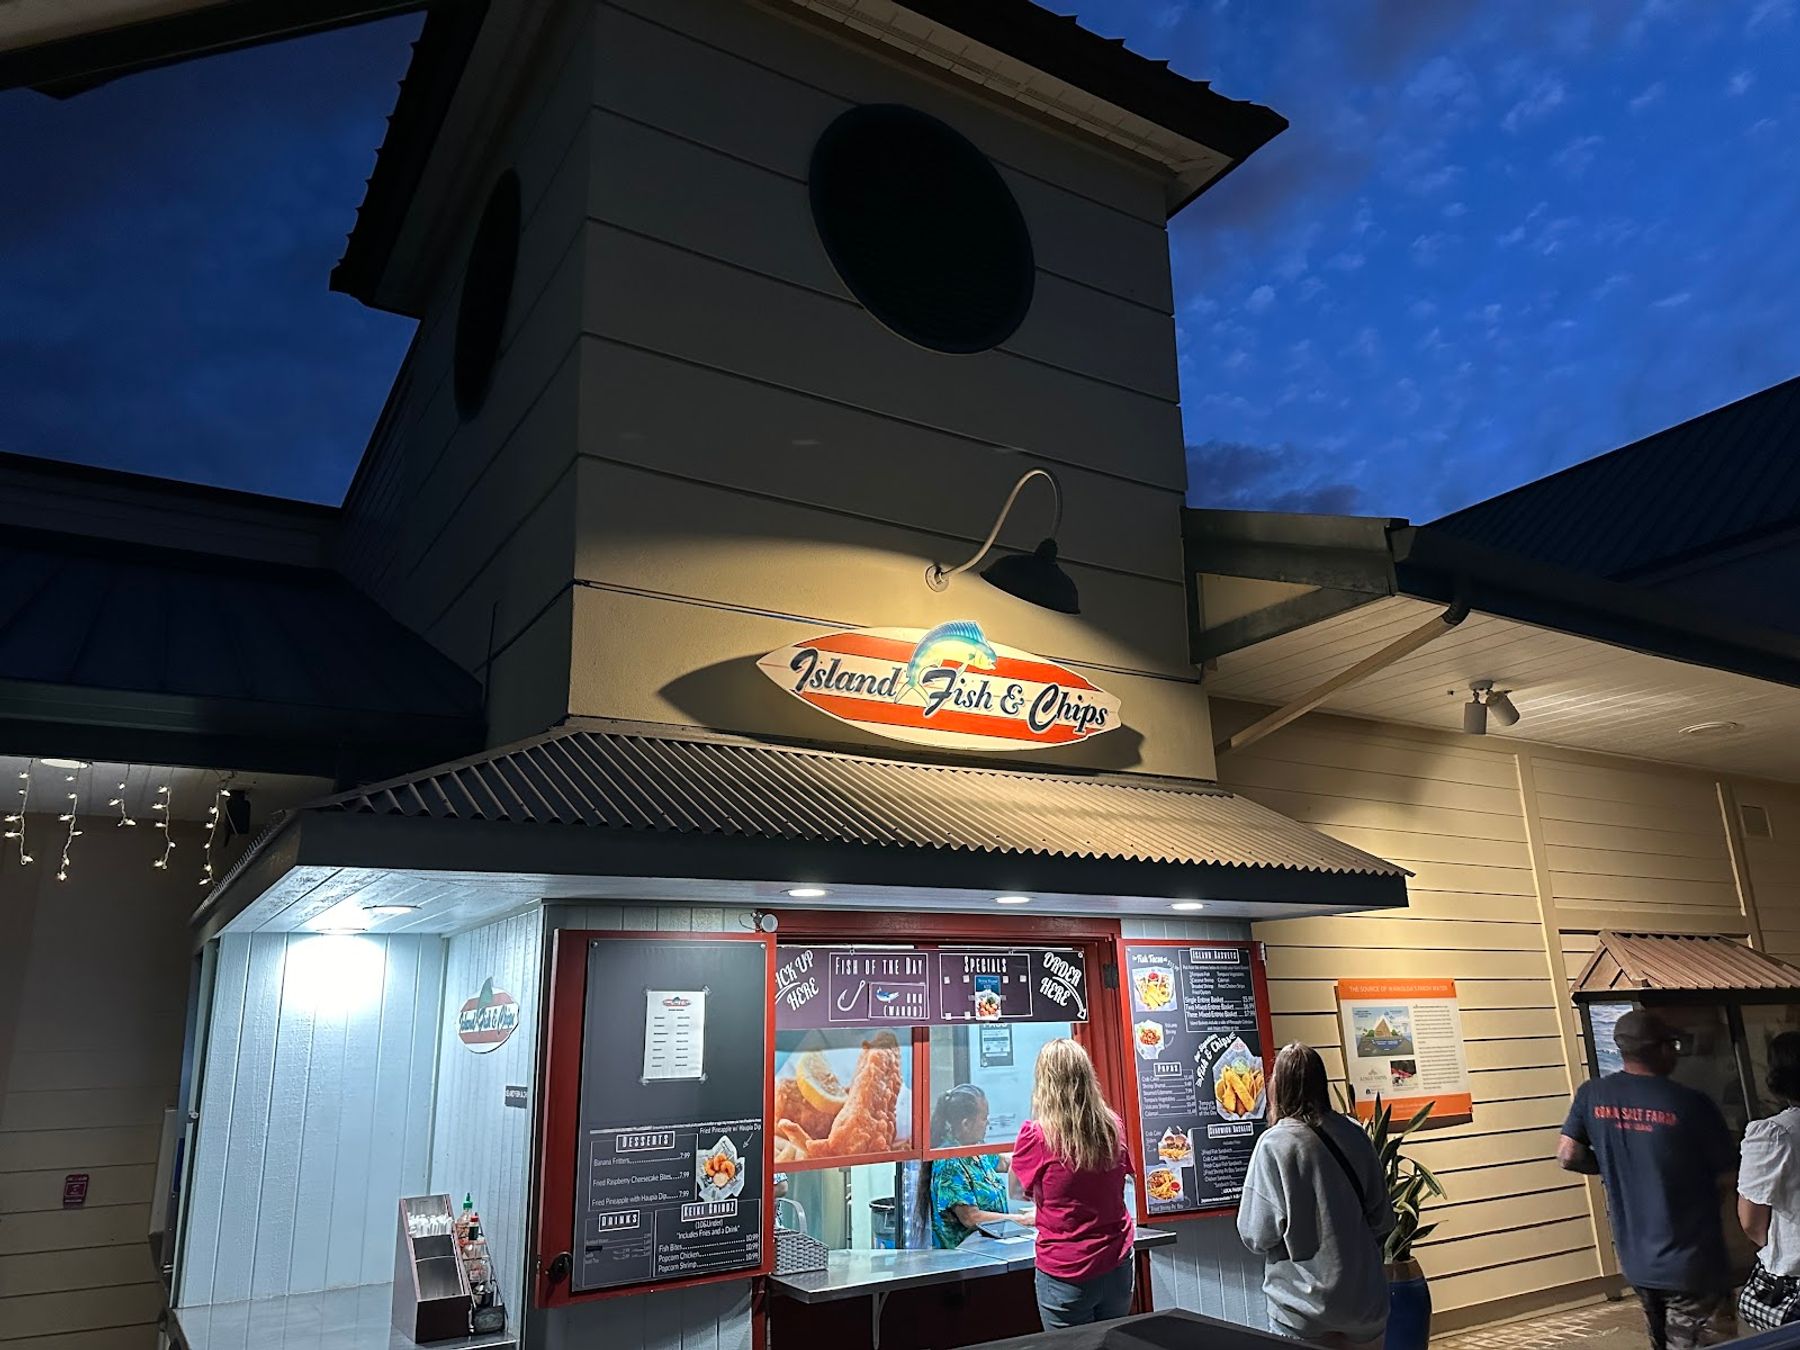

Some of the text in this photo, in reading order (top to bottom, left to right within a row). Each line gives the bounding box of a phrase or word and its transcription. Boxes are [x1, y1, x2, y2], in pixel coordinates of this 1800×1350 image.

[790, 648, 1108, 734] Island Fish & Chips
[776, 950, 813, 989] ICK UP
[835, 957, 858, 975] FISH
[865, 959, 876, 975] OF
[883, 959, 899, 975] THE
[964, 955, 1007, 973] SPECIALS
[1043, 952, 1082, 987] ORDER
[787, 977, 819, 1011] HERE
[1040, 977, 1071, 1007] HERE
[1204, 1048, 1213, 1060] &
[622, 1134, 669, 1148] DESSERTS
[592, 1199, 605, 1207] Fried
[602, 1214, 637, 1226] DRINKS
[699, 1229, 710, 1237] Fries
[659, 1244, 669, 1252] Fish
[659, 1254, 679, 1263] Popcorn
[659, 1264, 679, 1273] Popcorn
